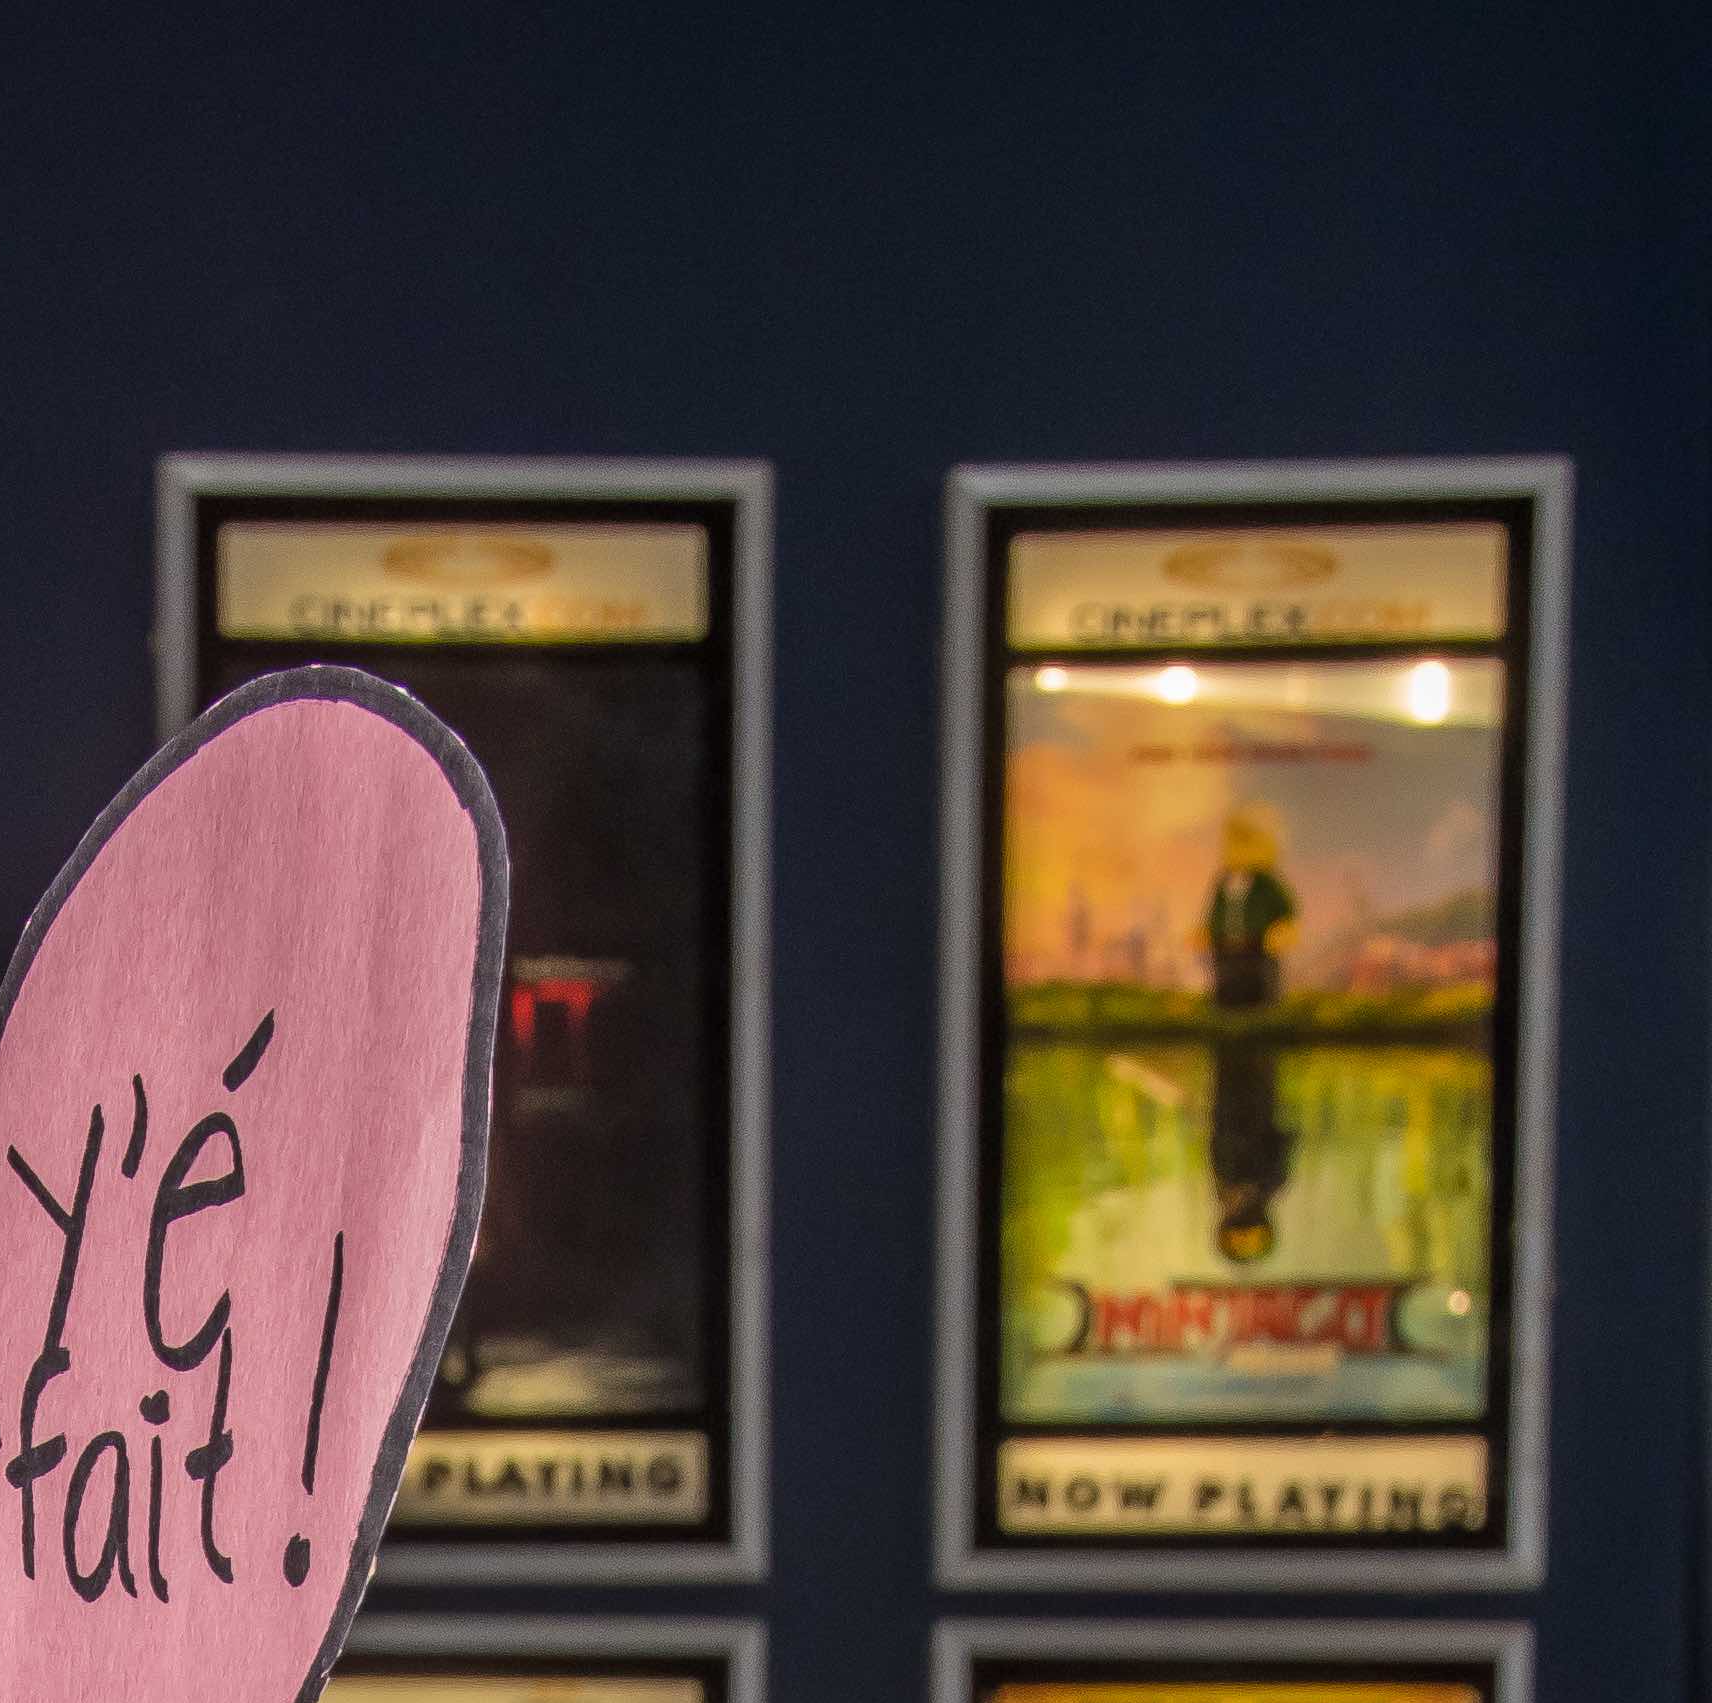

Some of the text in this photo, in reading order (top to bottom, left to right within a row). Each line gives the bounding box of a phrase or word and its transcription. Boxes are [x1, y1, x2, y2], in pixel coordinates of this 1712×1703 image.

[420, 1453, 687, 1493] PLAYING
[1014, 1476, 1484, 1529] NOW PLAYING
